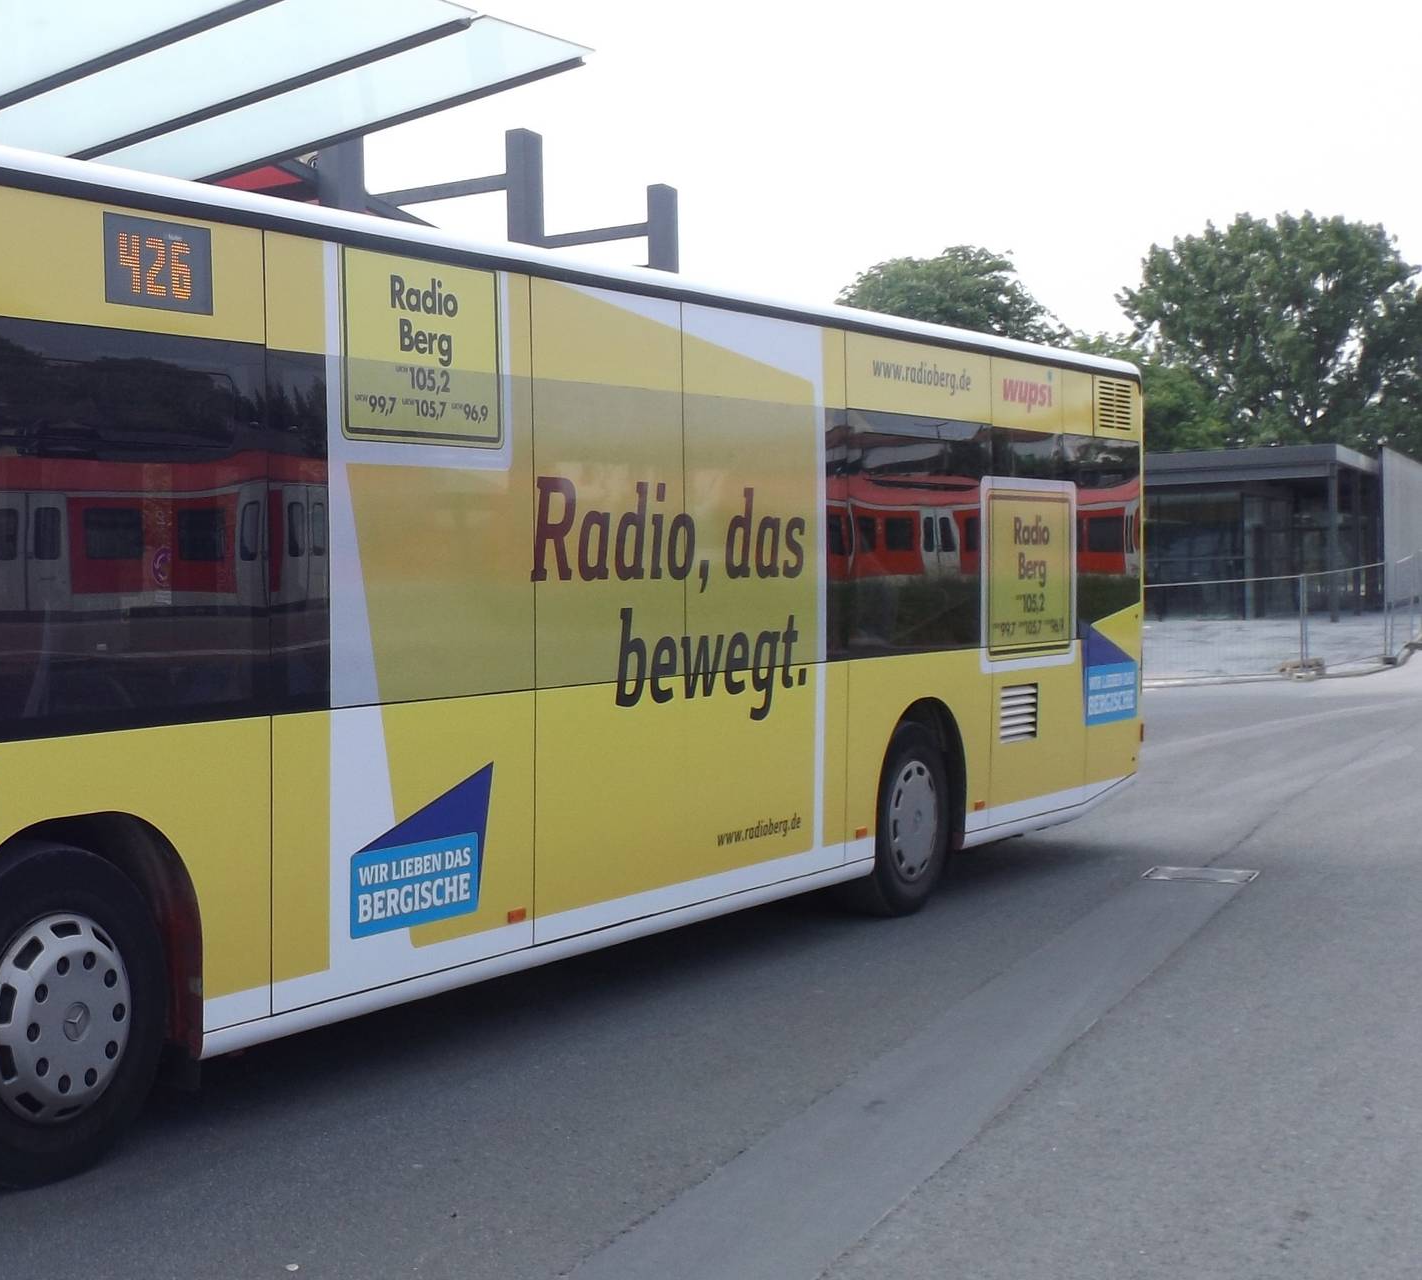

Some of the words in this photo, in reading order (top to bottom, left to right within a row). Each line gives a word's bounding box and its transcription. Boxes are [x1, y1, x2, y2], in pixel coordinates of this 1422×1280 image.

[119, 232, 191, 299] 426
[390, 274, 458, 318] Radio
[399, 318, 452, 367] Berg
[409, 366, 451, 395] 105,2
[872, 360, 972, 396] www.radioberg.de
[368, 394, 397, 416] 99,7
[415, 398, 447, 420] 105,7
[463, 403, 489, 424] 96,9
[530, 475, 710, 593] Radio,
[725, 486, 806, 580] das
[1013, 515, 1050, 546] Radio
[1018, 552, 1046, 588] Berg
[615, 607, 807, 721] bewegt.
[717, 812, 802, 847] www.radioberg.de
[359, 863, 389, 887] WIR
[392, 852, 442, 881] LIEBEN
[445, 846, 471, 870] DAS
[358, 872, 471, 924] BERGISCHE
